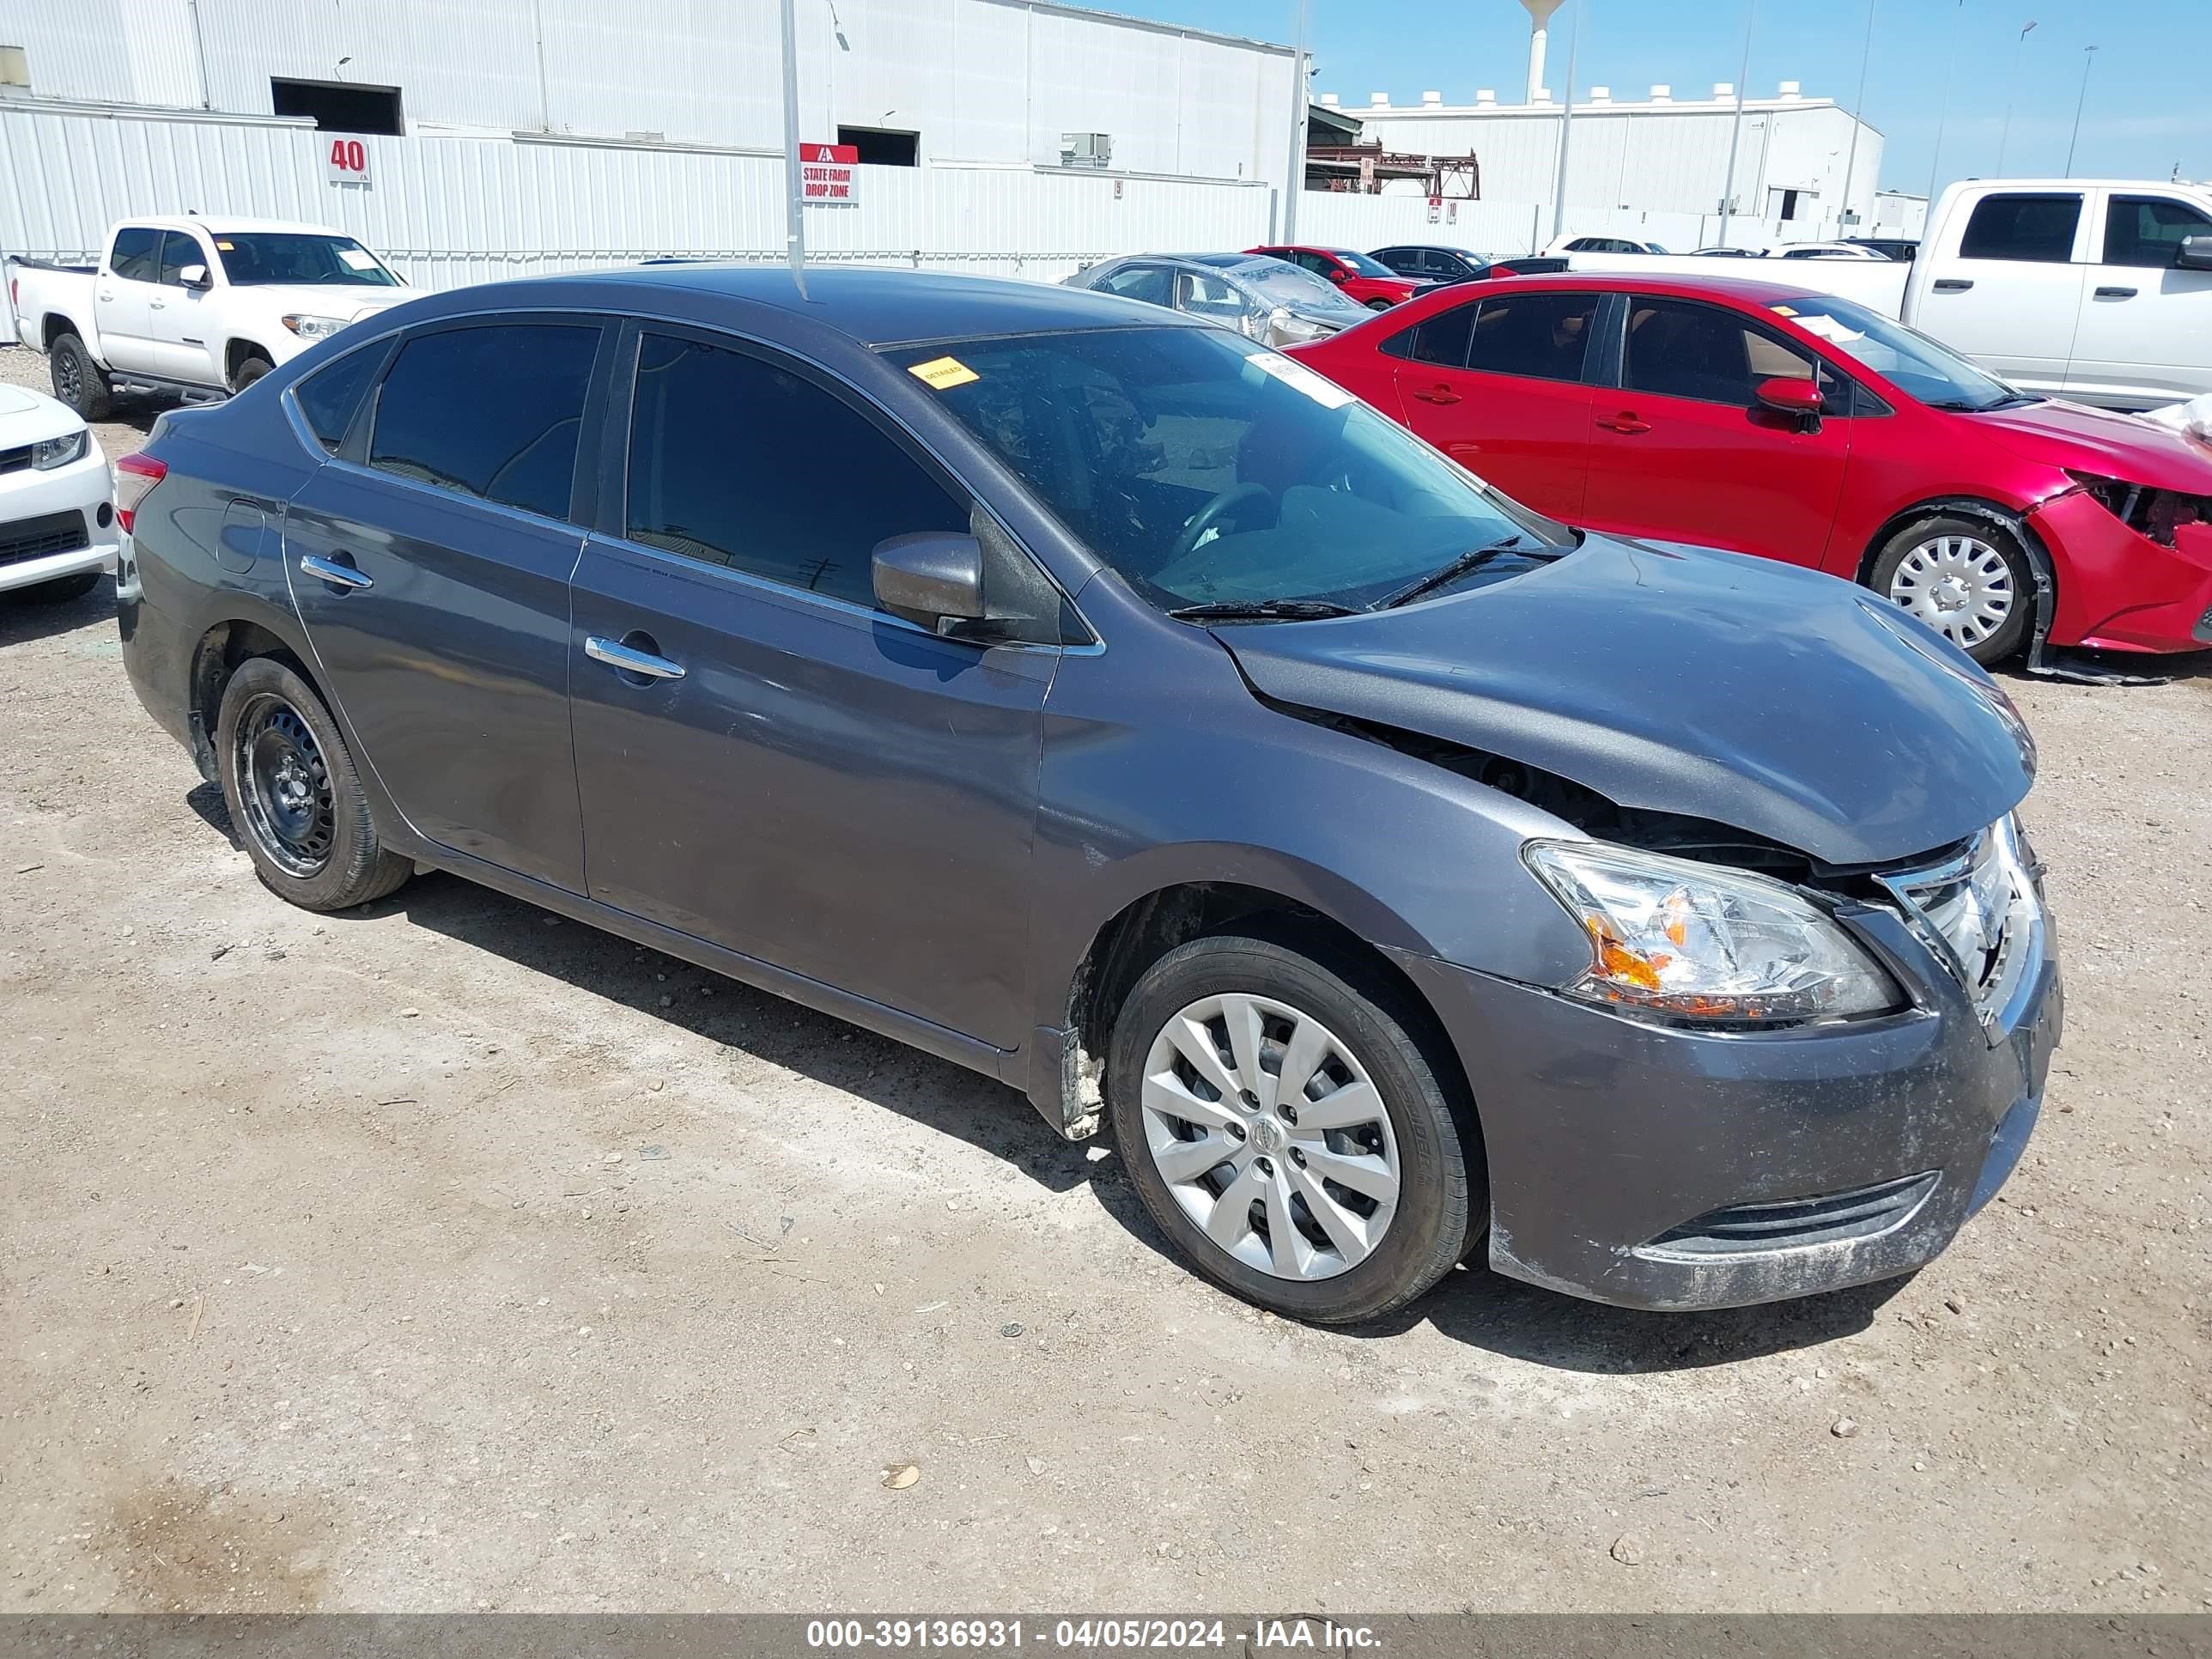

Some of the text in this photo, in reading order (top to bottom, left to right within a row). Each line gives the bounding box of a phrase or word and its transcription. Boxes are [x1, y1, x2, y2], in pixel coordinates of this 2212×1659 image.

[331, 140, 364, 172] 40
[804, 167, 851, 182] STATE FARM
[805, 184, 849, 198] DROP ZONE
[1116, 182, 1121, 194] 5
[1449, 203, 1457, 217] 10
[925, 367, 962, 380] DETAILED
